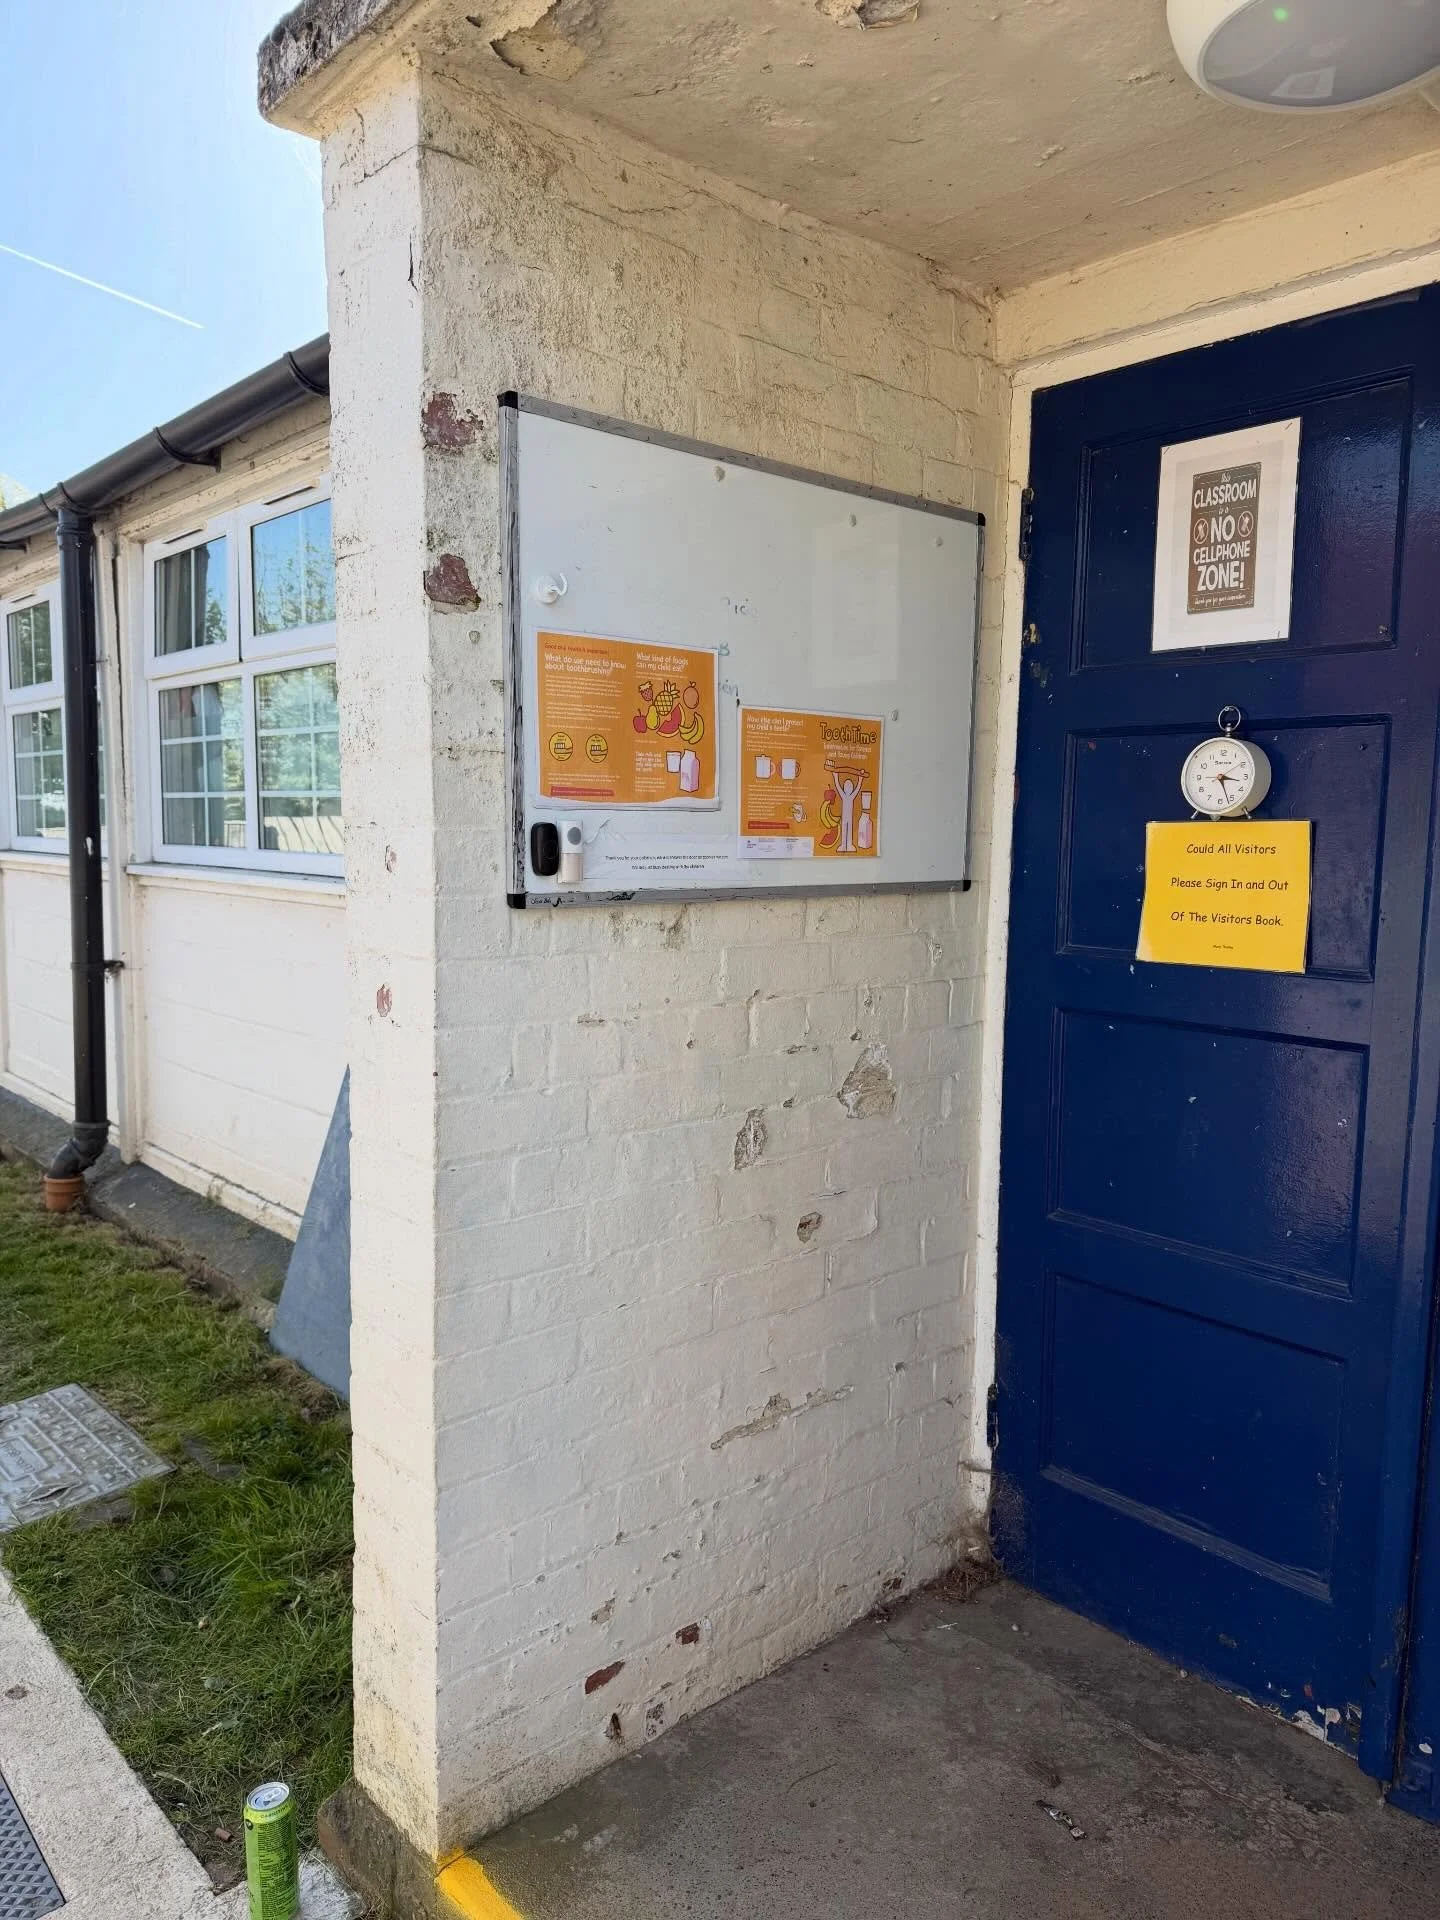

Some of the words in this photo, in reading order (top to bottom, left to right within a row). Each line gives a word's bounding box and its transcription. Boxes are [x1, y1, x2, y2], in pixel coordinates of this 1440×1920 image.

[1194, 479, 1257, 509] CLASSROOM
[1211, 515, 1236, 544] NO
[1193, 540, 1251, 565] CELLPHONE
[1197, 561, 1245, 591] ZONE!
[544, 653, 562, 663] What
[563, 655, 573, 663] do
[585, 657, 601, 666] need
[602, 659, 610, 667] to
[610, 660, 627, 669] know
[544, 662, 565, 671] about
[647, 663, 657, 671] my
[1186, 843, 1214, 854] Could
[1217, 843, 1231, 854] All
[1235, 844, 1277, 854] Visitors
[1170, 877, 1202, 888] Please
[1205, 878, 1228, 891] Sign
[1231, 879, 1243, 889] In
[1245, 880, 1265, 890] and
[1268, 880, 1288, 891] Out
[1170, 911, 1185, 922] Of
[1188, 911, 1208, 923] The
[1211, 912, 1252, 924] Visitors
[1255, 914, 1284, 926] Book.
